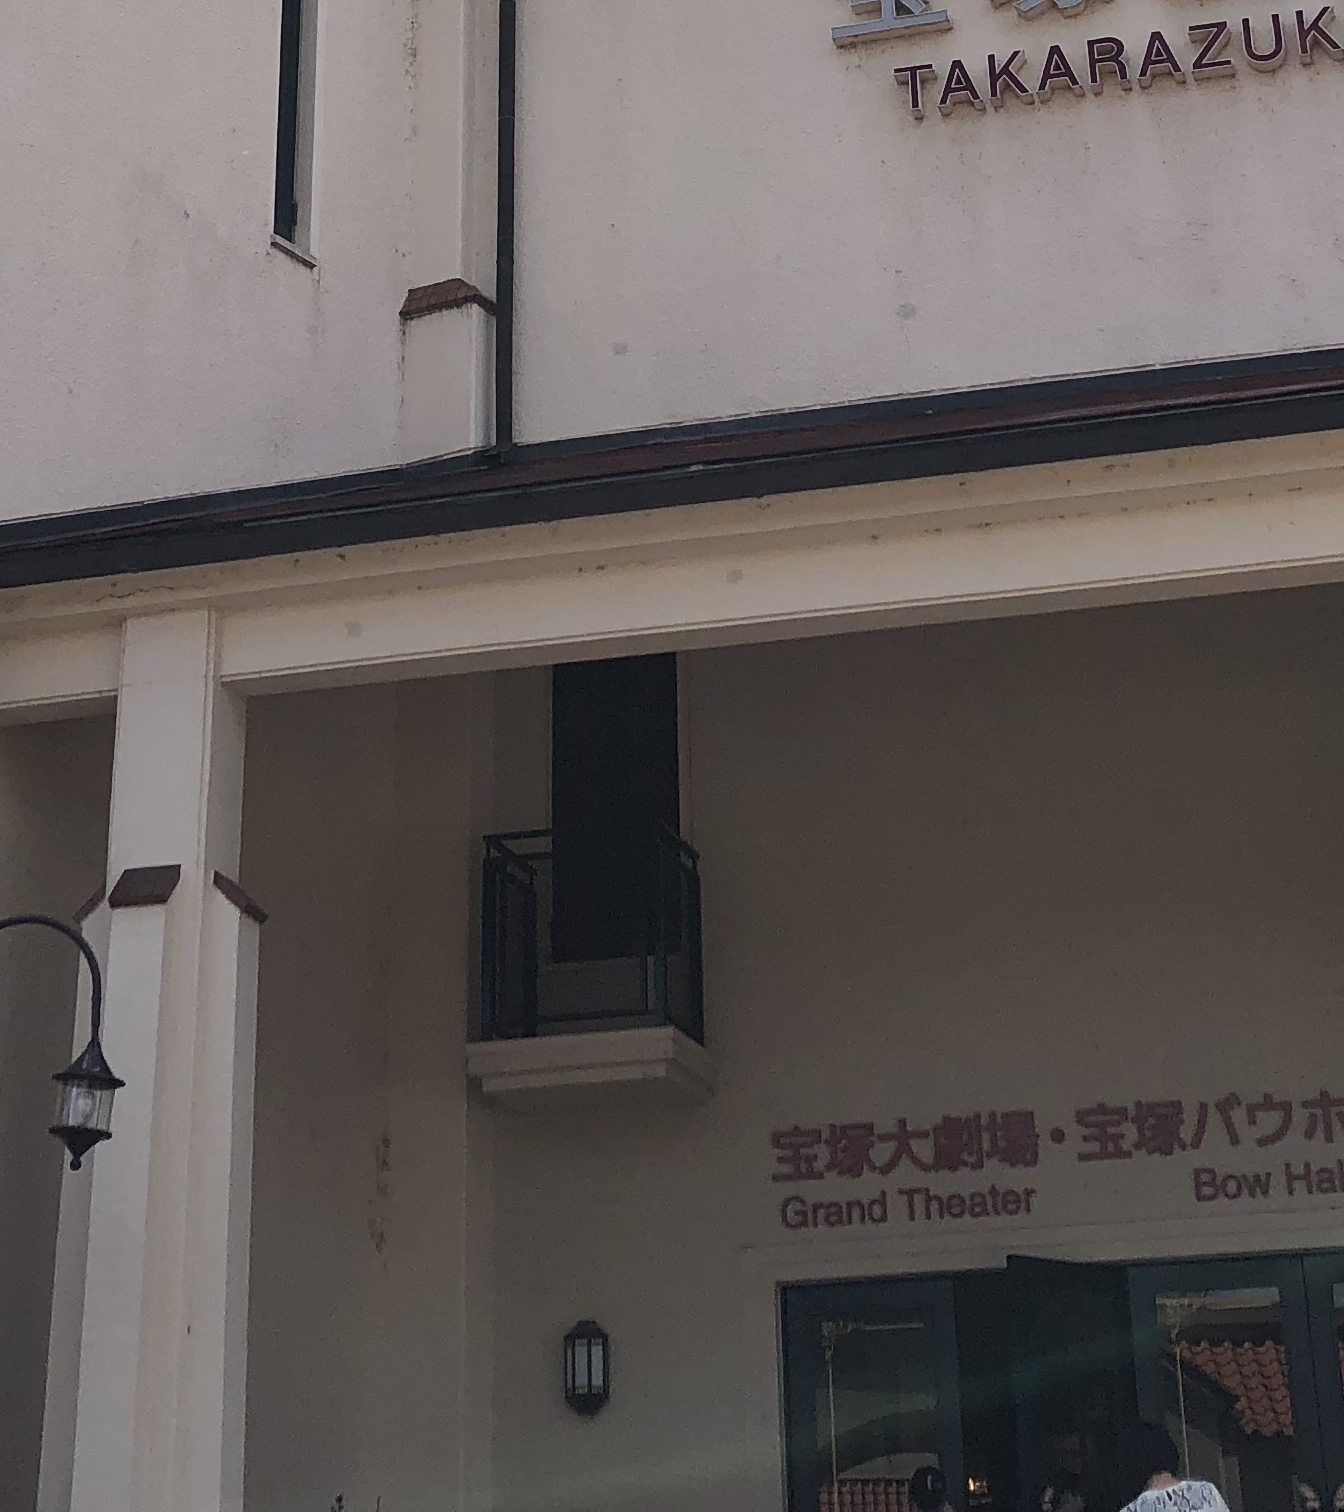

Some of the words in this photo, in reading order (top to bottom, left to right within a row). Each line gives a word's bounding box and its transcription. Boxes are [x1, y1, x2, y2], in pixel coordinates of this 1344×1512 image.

[1193, 1166, 1272, 1203] Bow
[780, 1189, 888, 1230] Grand
[897, 1184, 1036, 1222] Theater
